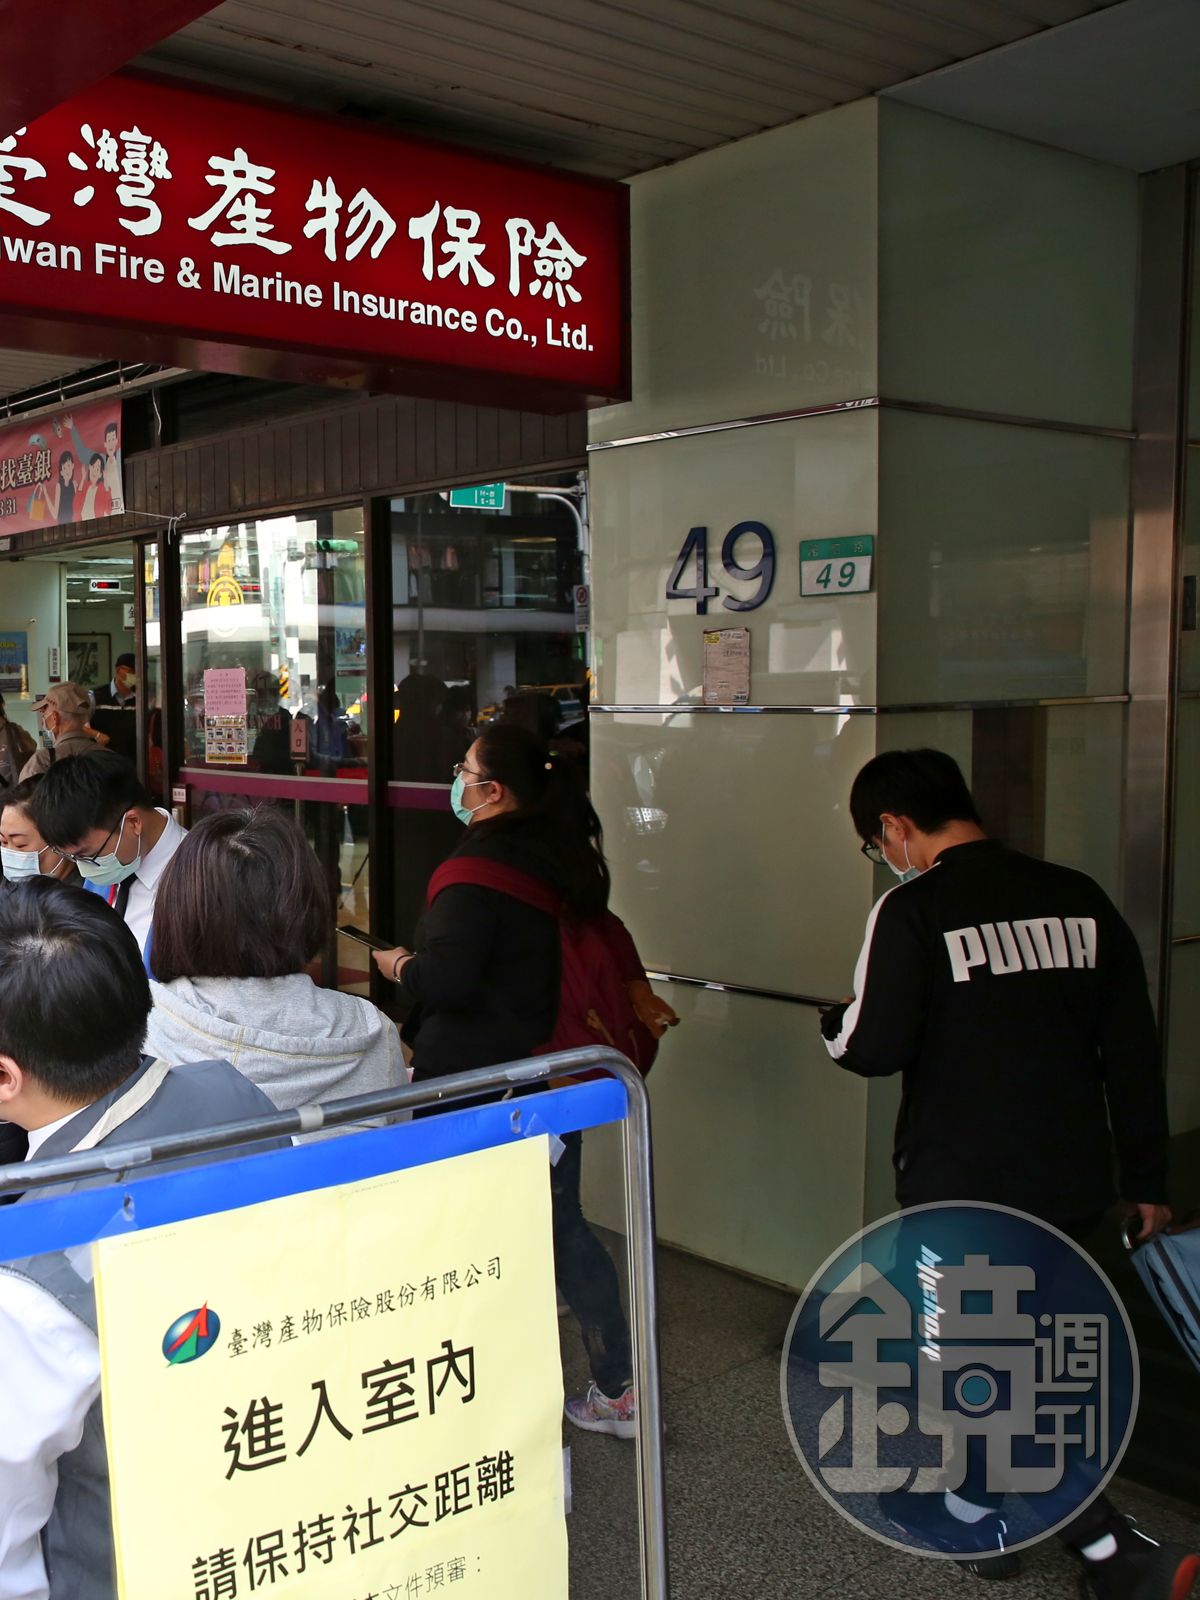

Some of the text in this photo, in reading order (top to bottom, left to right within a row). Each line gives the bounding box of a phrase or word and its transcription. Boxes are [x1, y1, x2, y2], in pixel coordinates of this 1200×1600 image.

[95, 242, 165, 284] Fire
[176, 256, 202, 290] &
[212, 261, 323, 308] Marine
[333, 281, 478, 333] Insurance
[484, 308, 538, 348] Co.,
[546, 318, 595, 352] Ltd.
[665, 520, 777, 617] 49
[815, 561, 856, 589] 49
[942, 917, 1098, 983] PUMA
[226, 1256, 503, 1360] 臺灣產物保險股份有限公司
[220, 1339, 477, 1481] 進入室內
[191, 1449, 516, 1600] 請保持社交距離
